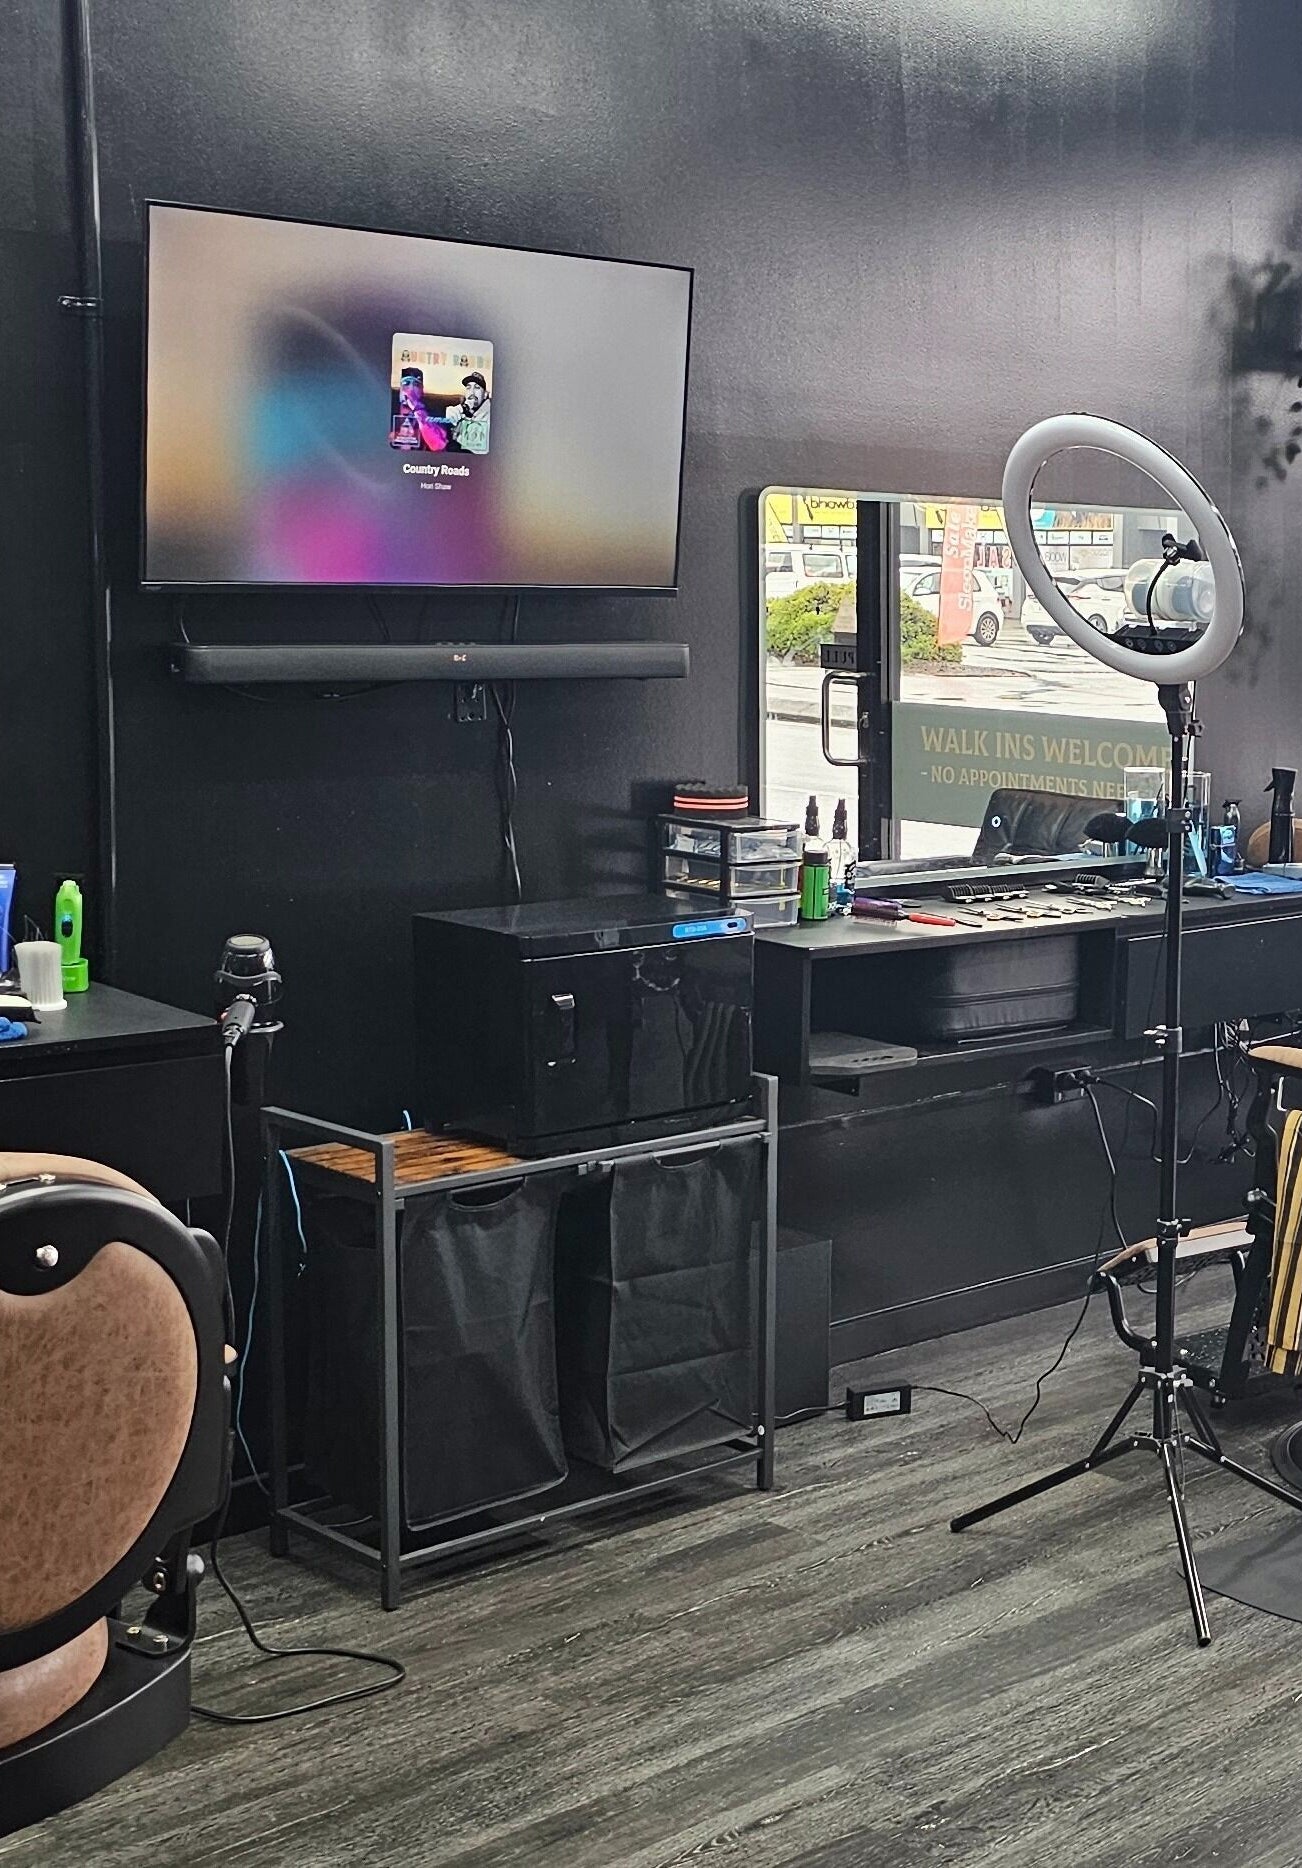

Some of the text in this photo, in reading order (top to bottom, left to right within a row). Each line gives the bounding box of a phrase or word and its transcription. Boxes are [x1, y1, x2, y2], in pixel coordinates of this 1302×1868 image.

[403, 463, 470, 477] Country Roads
[921, 725, 990, 757] WALK
[995, 731, 1034, 761] INS
[931, 765, 956, 785] NO
[958, 767, 1088, 798] APPOINTMENTS
